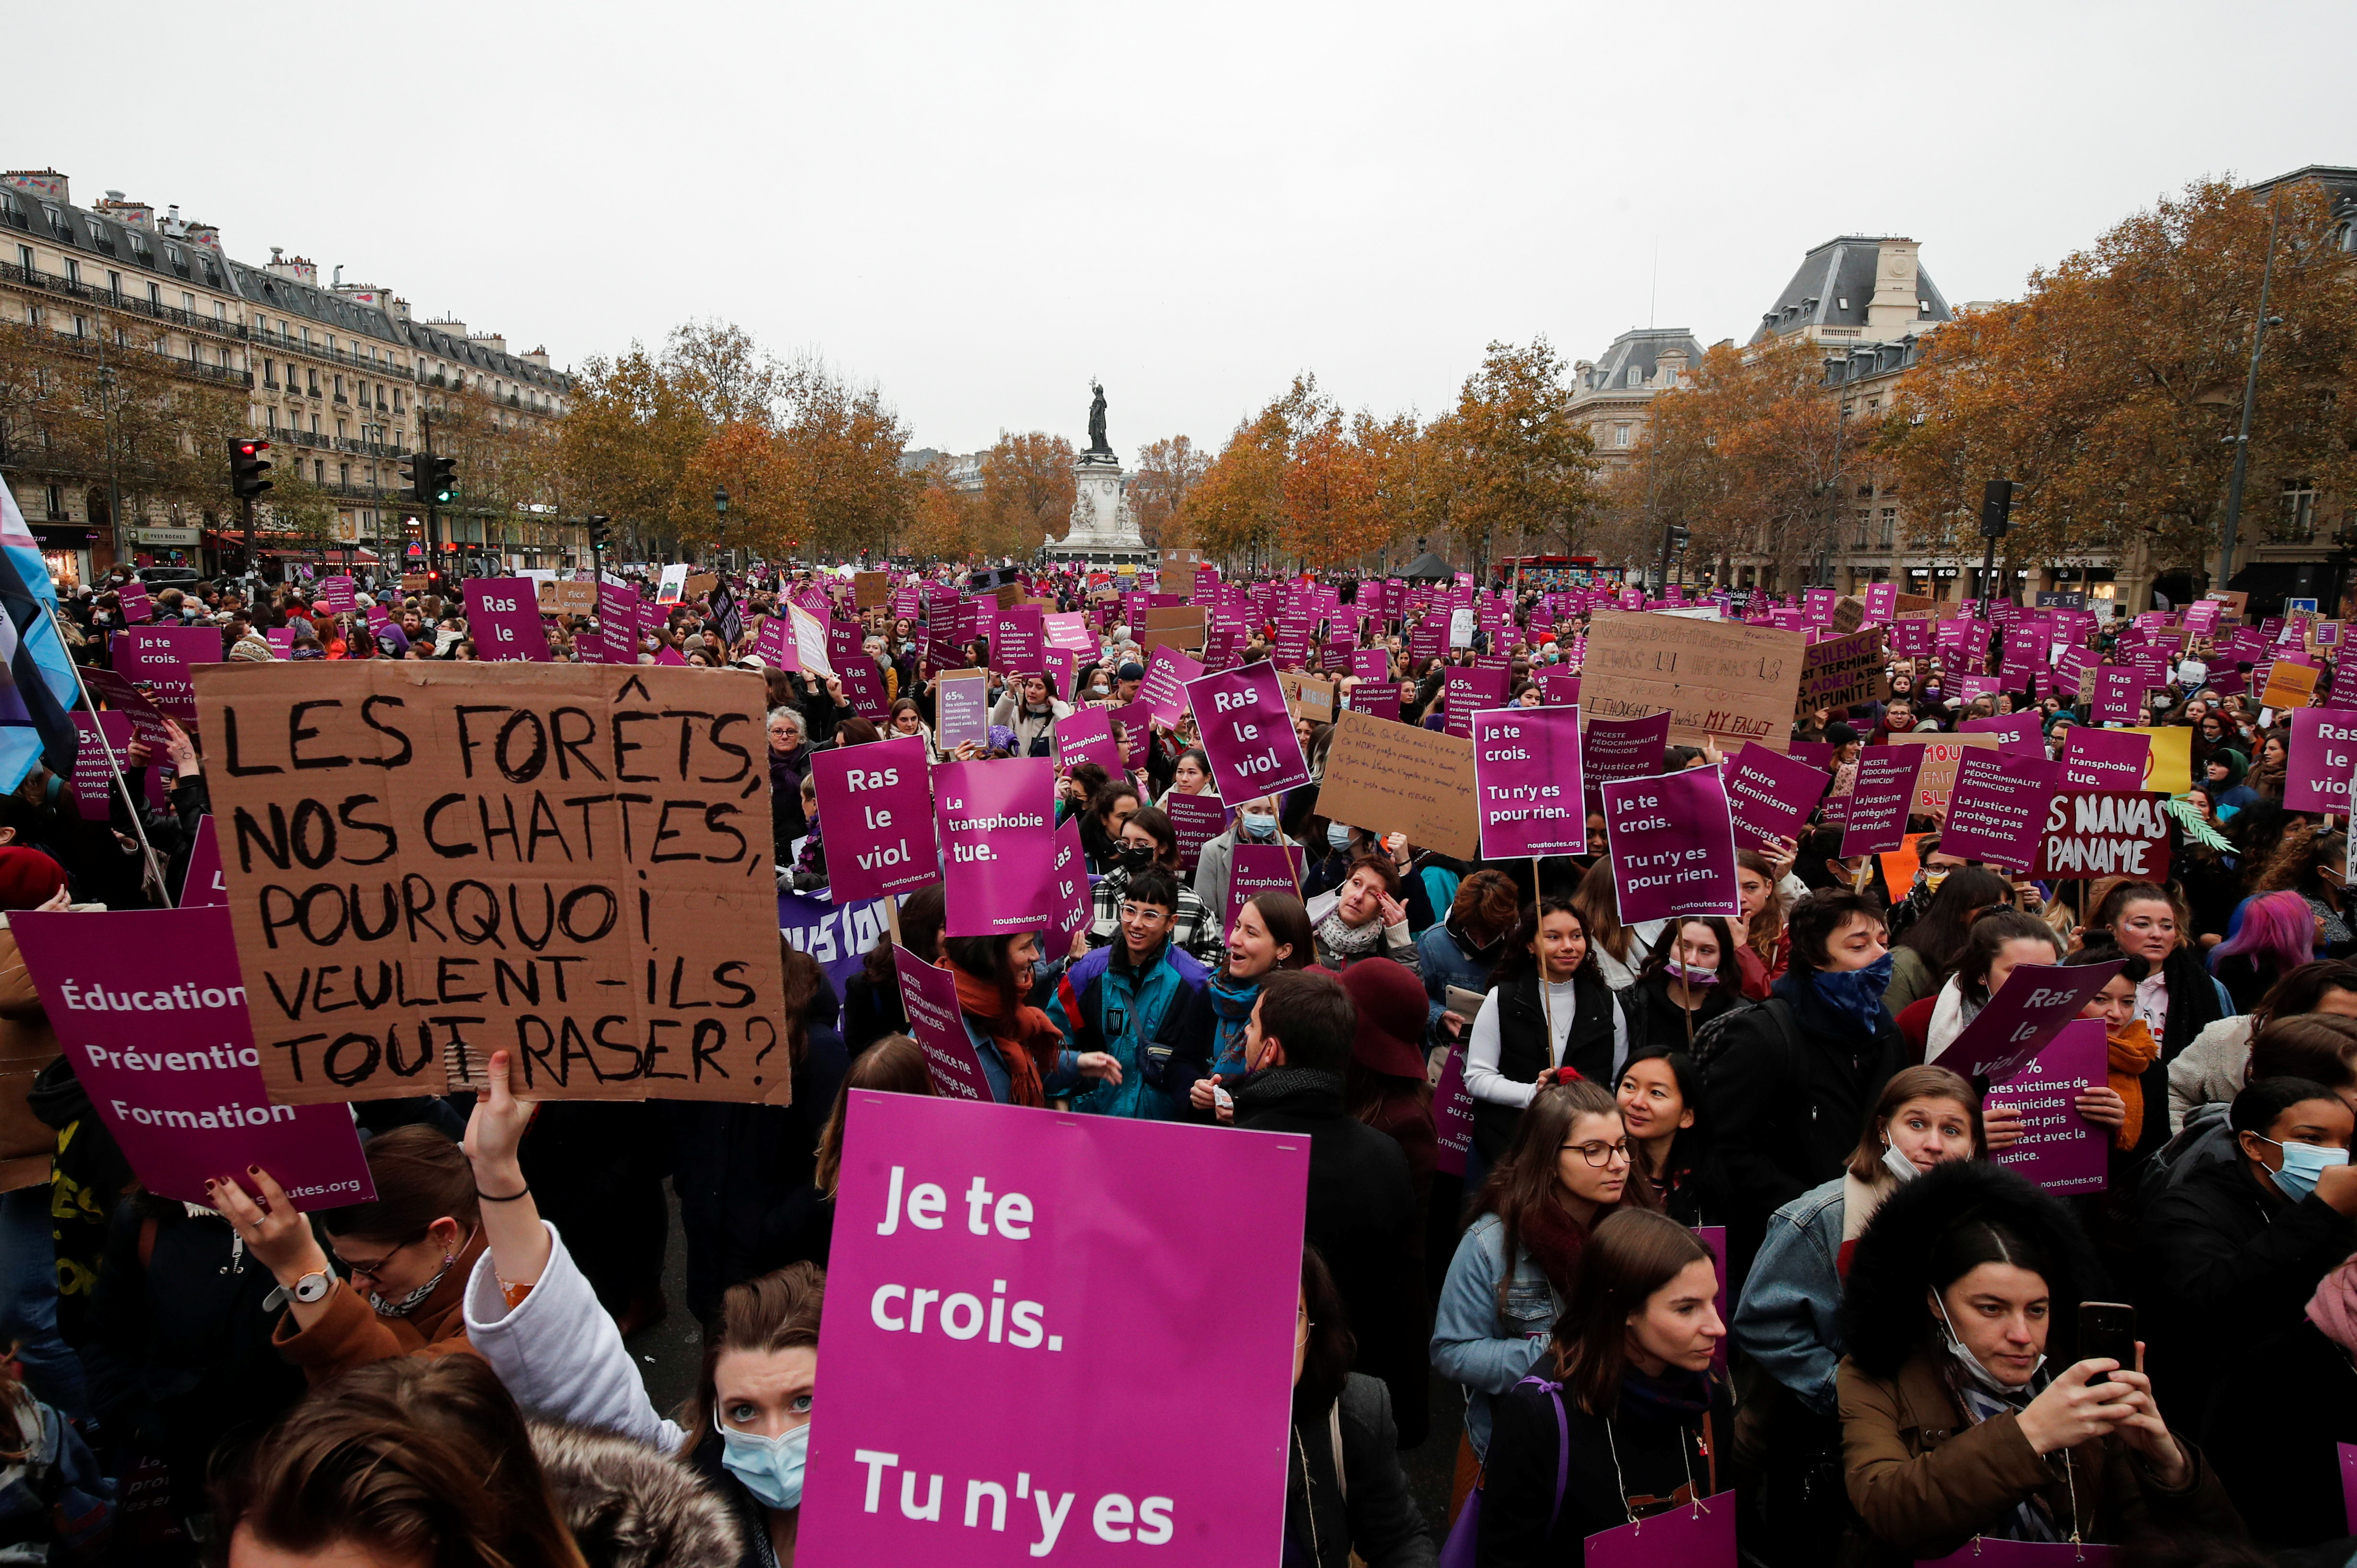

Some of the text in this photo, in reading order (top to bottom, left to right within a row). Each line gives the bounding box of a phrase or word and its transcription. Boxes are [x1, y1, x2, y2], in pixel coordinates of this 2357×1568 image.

[482, 596, 516, 611] Ras
[567, 591, 585, 599] FUCK
[1388, 598, 1396, 606] le
[2043, 595, 2078, 606] JE TE
[495, 624, 513, 641] le
[1000, 621, 1017, 631] 65%
[1047, 624, 1080, 634] féminisme
[1054, 634, 1085, 643] antiraciste.
[1809, 634, 1879, 666] SILENCE
[846, 667, 867, 678] Ras
[1155, 657, 1176, 674] 65%
[1691, 654, 1715, 676] HE
[1719, 658, 1749, 677] WAS
[1752, 657, 1783, 683] 18
[1149, 674, 1177, 691] féminicides
[1449, 679, 1473, 690] 65%
[1810, 665, 1884, 693] ADIEU TON
[2109, 674, 2131, 683] Ras
[855, 683, 867, 694] le
[2112, 688, 2123, 697] le
[855, 699, 878, 711] viol
[1214, 688, 1258, 713] Ras
[1355, 705, 1371, 714] Bla
[2105, 702, 2127, 712] viol
[1449, 721, 1468, 729] justice.
[1603, 698, 1652, 718] THOUGHT
[1675, 709, 1699, 727] WAS
[1703, 710, 1731, 730] MY
[1731, 716, 1774, 736] FAULT
[224, 674, 762, 799] LES FORÊTS,
[1060, 734, 1070, 742] La
[1233, 722, 1258, 742] le
[1484, 725, 1520, 741] Je te
[1591, 734, 1658, 747] PÉDOCRIMINALITÉ
[2319, 724, 2357, 741] Ras
[1061, 733, 1107, 752] transphobie
[1065, 754, 1089, 766] tue.
[1234, 748, 1281, 776] viol
[1486, 746, 1530, 761] crois.
[2326, 749, 2347, 767] le
[1966, 759, 2002, 772] INCESTE
[2070, 757, 2136, 772] transphobie
[847, 769, 898, 792] Ras
[1259, 773, 1305, 791] noustoutes.org
[1740, 766, 1775, 787] Notre
[1964, 769, 2041, 789] PÉDOCRIMINALITÉ
[2067, 770, 2099, 785] tue.
[2311, 774, 2355, 797] viol
[1488, 786, 1509, 799] Tu
[1542, 786, 1559, 796] es
[1962, 778, 2015, 794] FÉMINICIDES
[947, 797, 962, 809] La
[1617, 796, 1657, 814] Je te
[1731, 777, 1797, 815] féminisme
[1490, 805, 1570, 825] pour rien.
[1957, 796, 2029, 816] La justice ne
[865, 806, 891, 829] le
[949, 813, 1043, 832] transphobie
[1619, 816, 1671, 832] crois.
[1953, 809, 2024, 829] protège pas
[2075, 794, 2169, 838] NANAS
[233, 789, 761, 876] NOS CHATTES,
[1951, 821, 2017, 842] les enfants.
[857, 839, 910, 869] viol
[953, 843, 997, 862] tue.
[1624, 855, 1648, 867] Tu
[1686, 849, 1706, 859] es
[1980, 850, 2030, 867] noustoutes.org
[2047, 836, 2153, 874] PANAME
[882, 871, 935, 888] noustoutes.org
[1628, 868, 1718, 893] pour rien.
[1059, 880, 1073, 899] le
[1672, 902, 1733, 910] noustoutes.org
[993, 915, 1047, 925] noustoutes.org
[1061, 898, 1087, 936] viol
[901, 971, 921, 991] INCESTE
[61, 979, 248, 1010] Éducation
[2024, 988, 2078, 1008] Ras
[905, 987, 956, 1023] PÉDOCRIMINALITÉ
[908, 1005, 945, 1032] FÉMINICIDES
[2010, 1022, 2037, 1042] le
[85, 1043, 260, 1070] Préventio
[272, 1016, 486, 1087] TOUT
[918, 1036, 972, 1075] La justice ne
[959, 1082, 978, 1099] pas
[2016, 1077, 2088, 1092] victimes de
[111, 1100, 295, 1128] Formation
[2043, 1114, 2066, 1127] pris
[2044, 1128, 2085, 1141] avec la
[1998, 1152, 2039, 1166] justice.
[2041, 1176, 2102, 1187] noustoutes.org
[877, 1166, 1033, 1239] Je te
[871, 1279, 1062, 1351] crois.
[855, 1449, 1173, 1557] Tu n'y es
